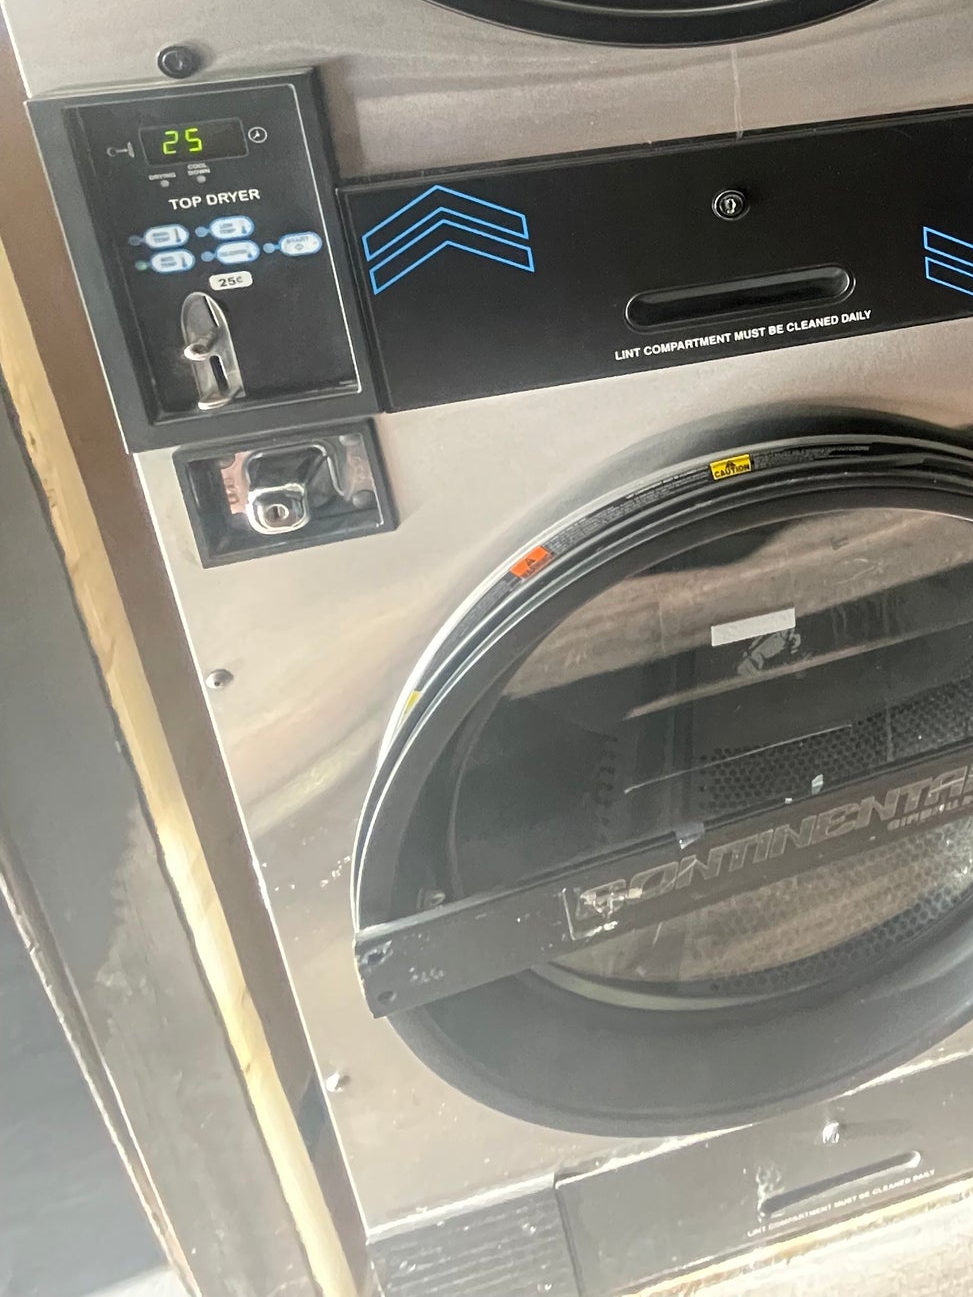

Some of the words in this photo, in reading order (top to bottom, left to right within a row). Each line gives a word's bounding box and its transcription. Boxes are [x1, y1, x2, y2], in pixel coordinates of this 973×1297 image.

[161, 128, 204, 155] 25
[168, 196, 202, 210] TOP
[206, 188, 261, 206] DRYER
[614, 348, 641, 361] LINT
[643, 333, 731, 356] COMPARTMENT
[734, 327, 765, 341] MUST
[768, 324, 784, 336] BE
[786, 315, 839, 332] CLEANED
[841, 310, 872, 324] DAILY
[714, 463, 750, 478] CAUTION
